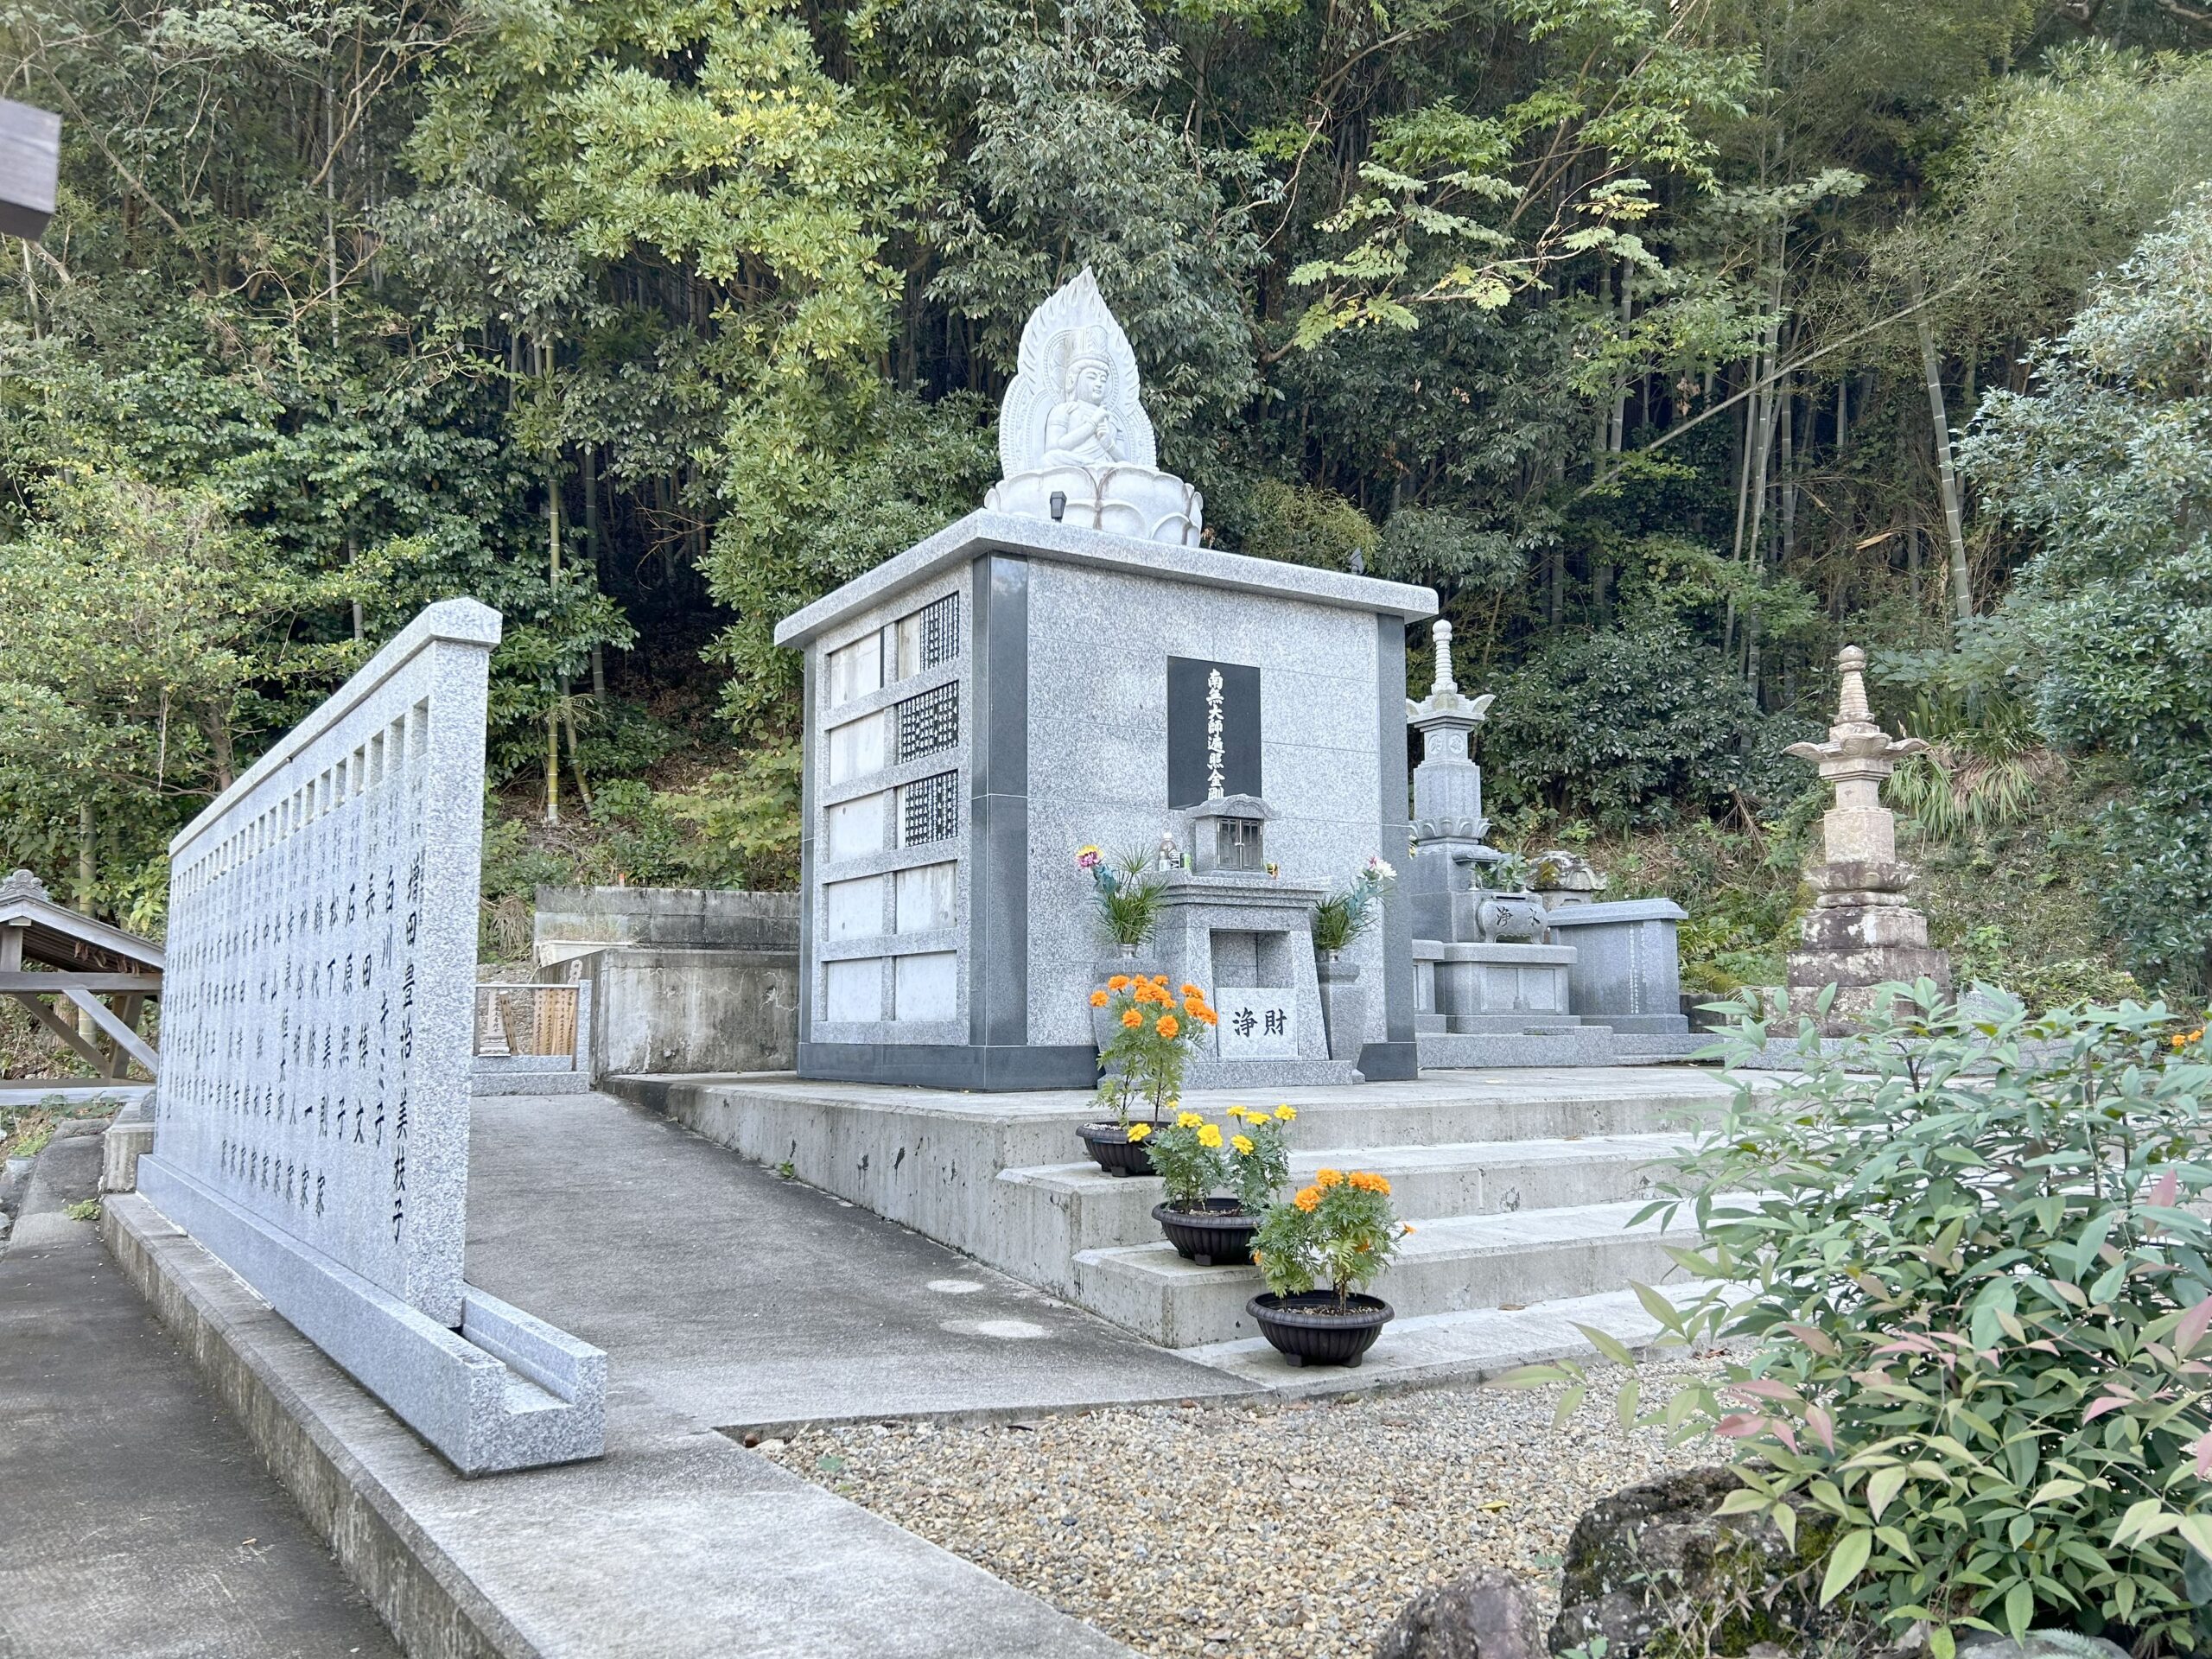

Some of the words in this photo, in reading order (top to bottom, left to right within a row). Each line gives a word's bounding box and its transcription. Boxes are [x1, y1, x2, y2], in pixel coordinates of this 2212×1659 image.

[1206, 669, 1225, 801] 南無大師遍照金剛
[353, 872, 375, 1144] 長田博文
[375, 864, 394, 1148] 白川キミ子
[1232, 1007, 1287, 1038] 浄財
